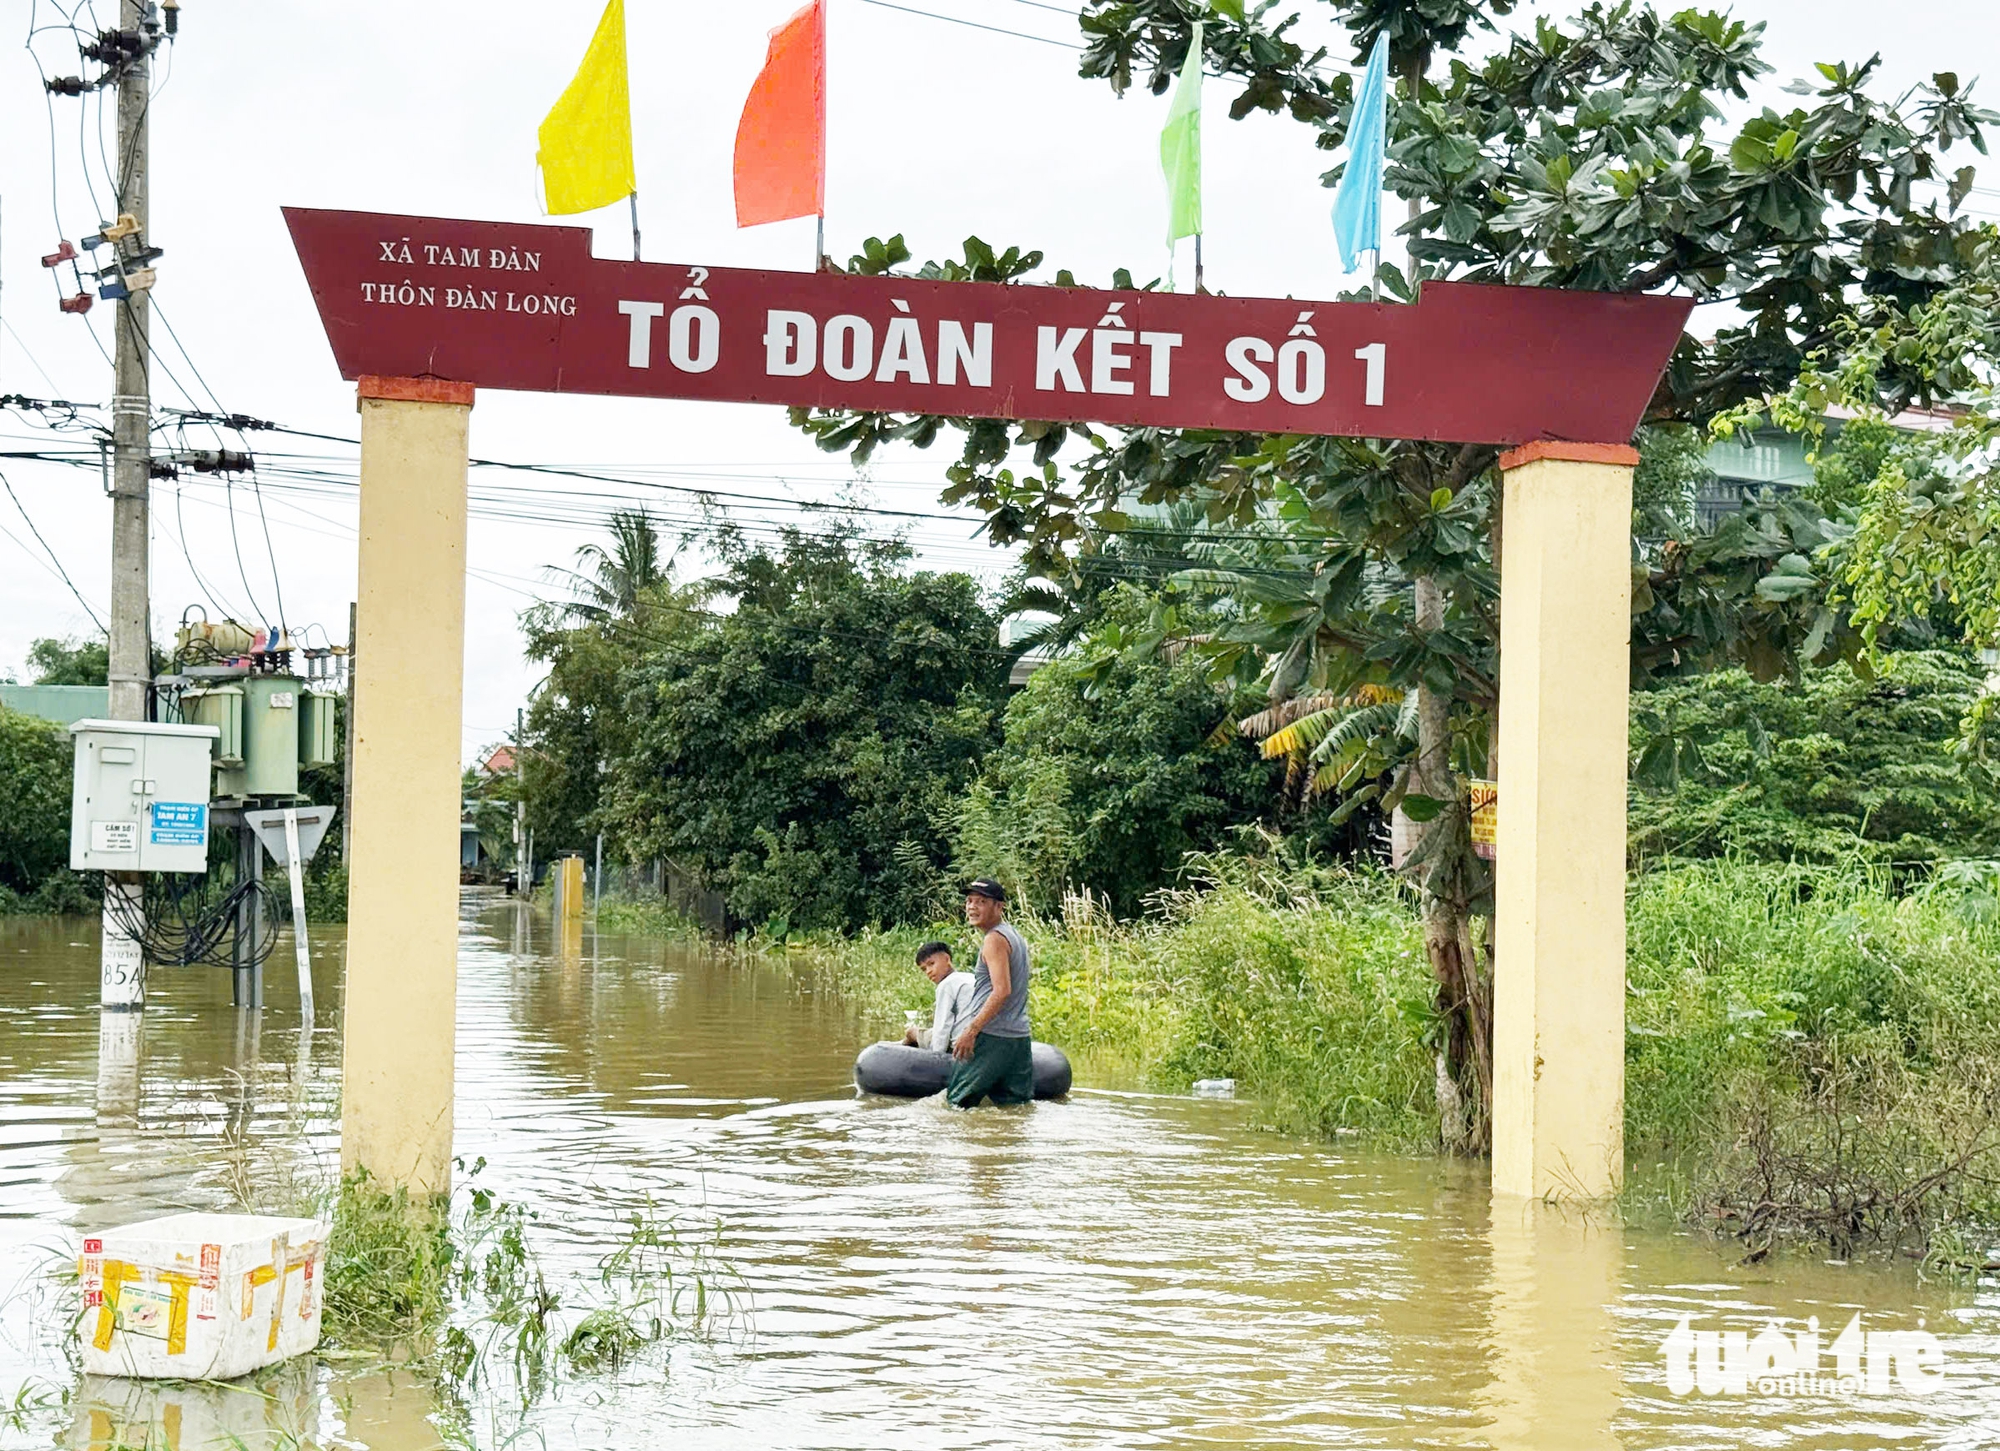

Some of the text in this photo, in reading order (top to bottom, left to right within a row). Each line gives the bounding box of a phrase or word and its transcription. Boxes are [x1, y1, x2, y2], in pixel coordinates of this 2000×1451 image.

[379, 237, 541, 272] XÃ TAM ĐÀN
[361, 279, 577, 317] THÔN ĐÀN LONG
[618, 267, 1386, 406] TỔ ĐOÀN KẾT SỐ 1
